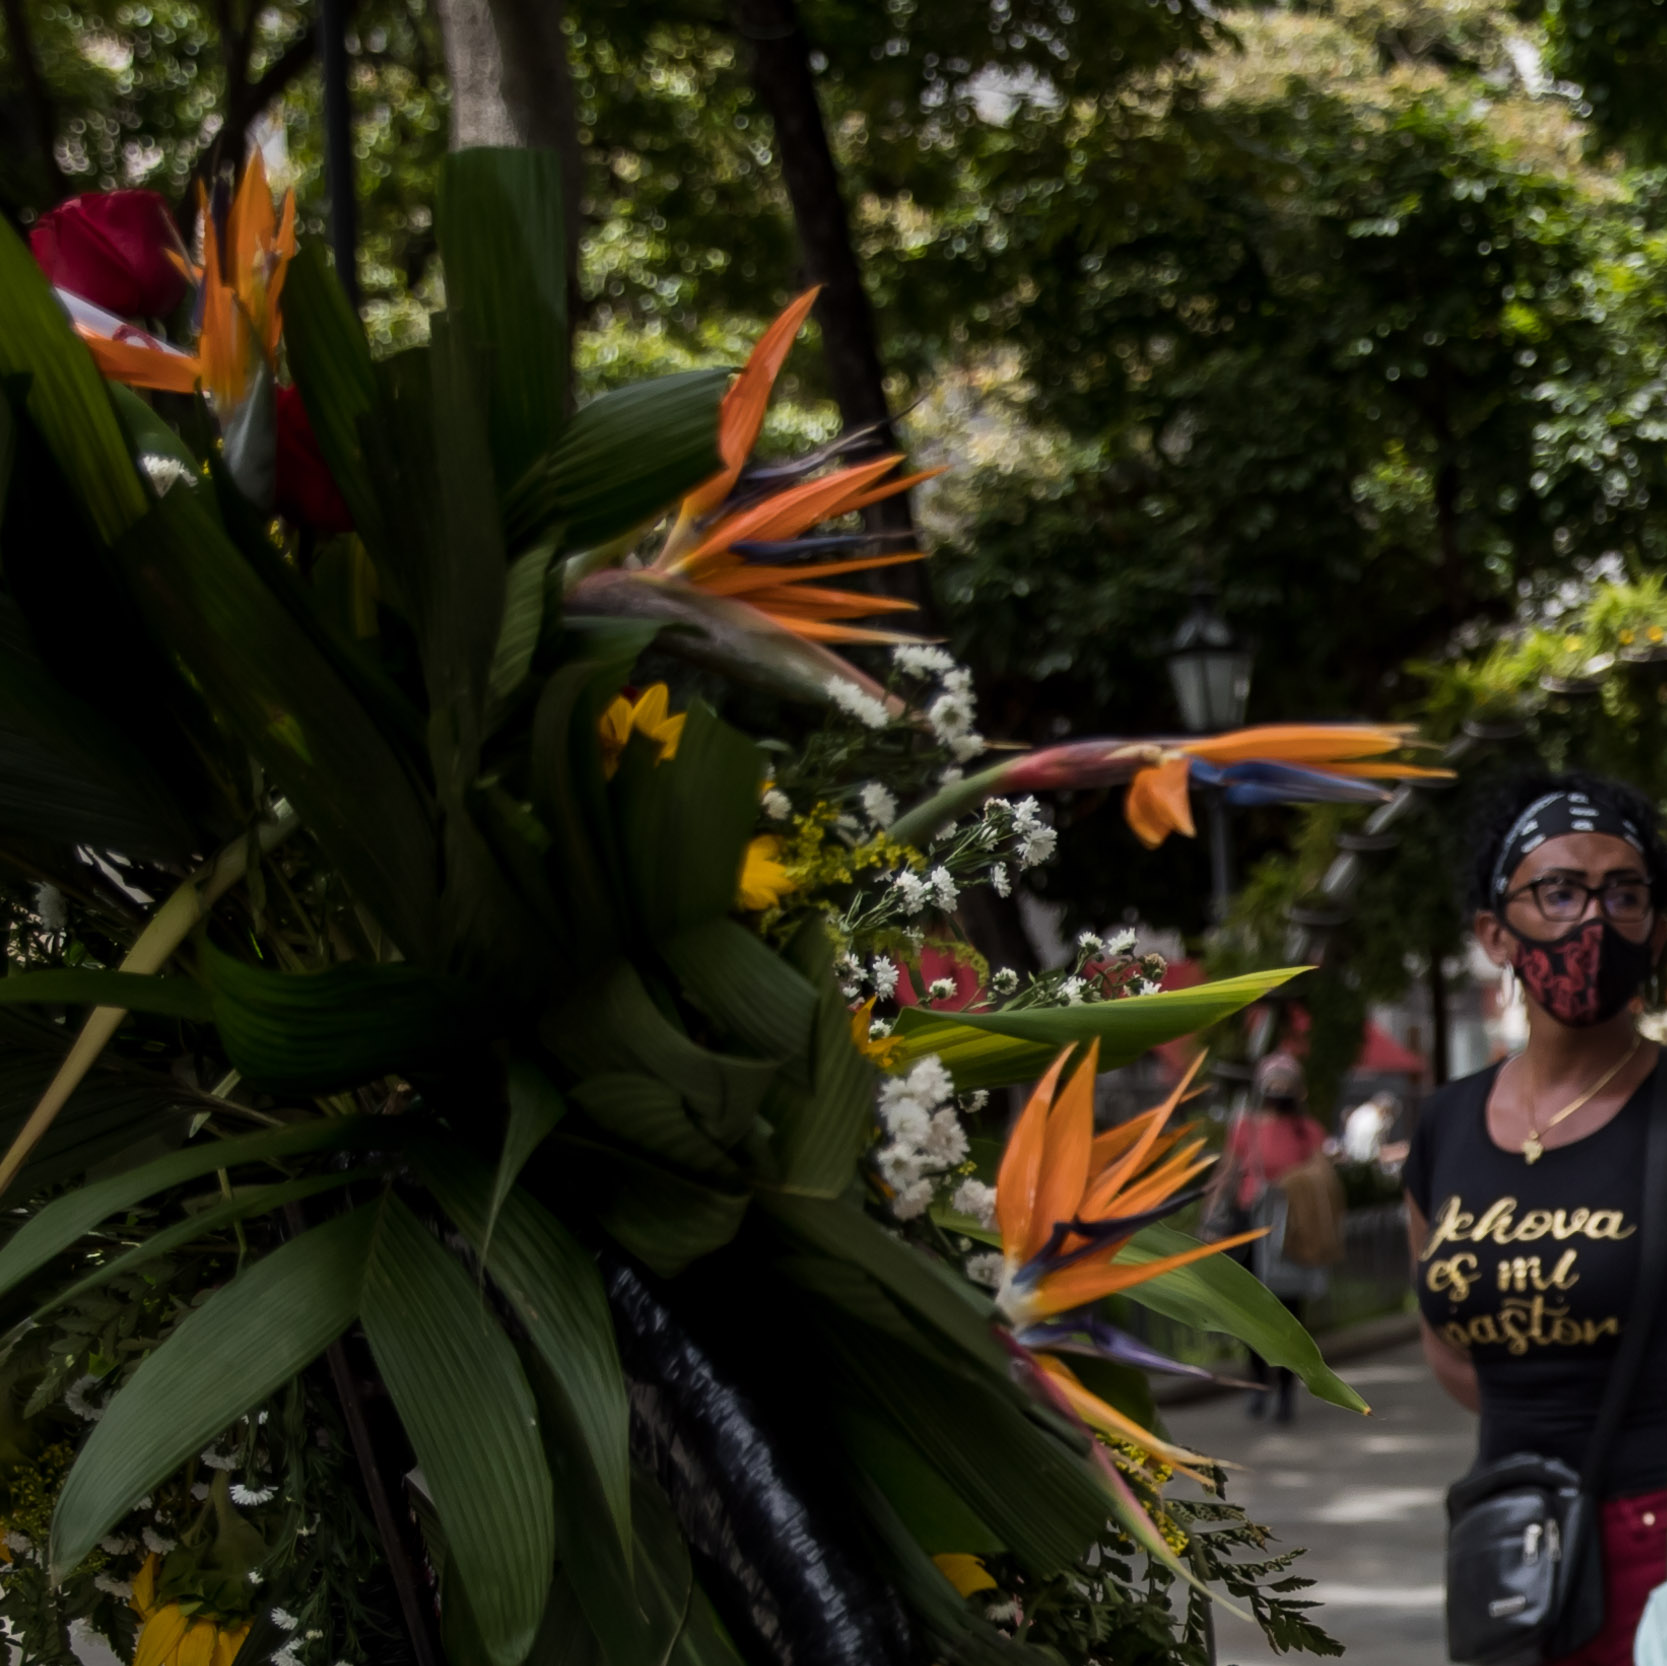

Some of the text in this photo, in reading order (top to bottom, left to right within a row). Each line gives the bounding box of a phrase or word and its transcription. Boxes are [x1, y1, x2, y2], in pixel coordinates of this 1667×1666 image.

[1418, 1194, 1638, 1262] Jehova
[1426, 1247, 1580, 1302] es mi
